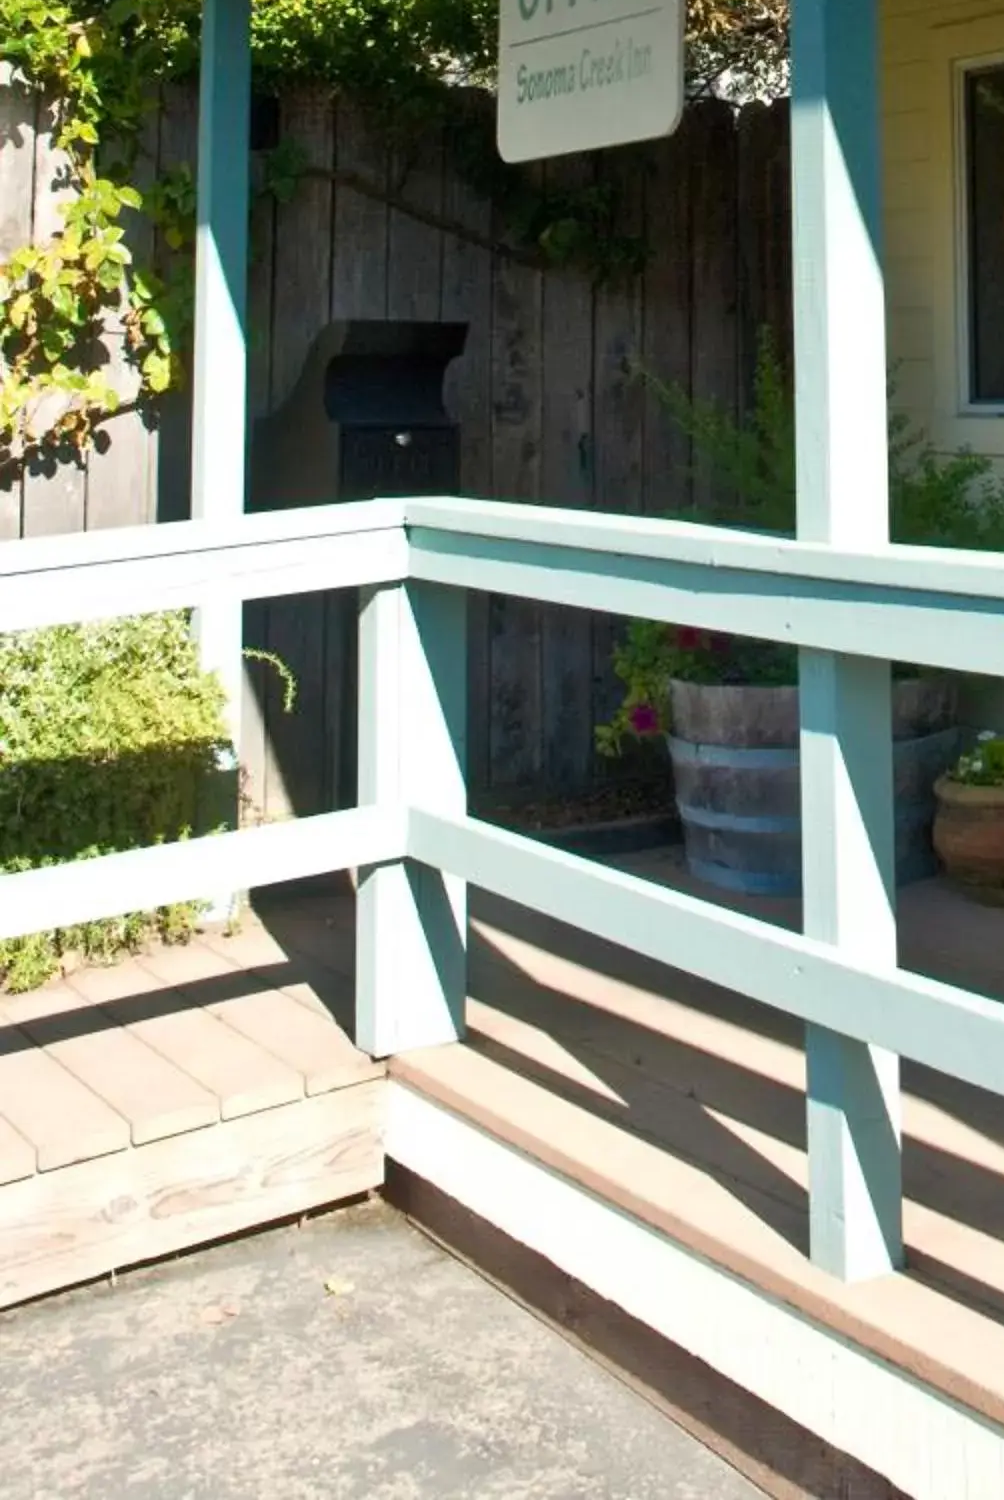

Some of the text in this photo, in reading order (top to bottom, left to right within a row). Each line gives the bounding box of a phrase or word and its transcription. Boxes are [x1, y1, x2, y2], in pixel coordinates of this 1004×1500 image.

[517, 36, 653, 104] Sonoma Creek Inn
